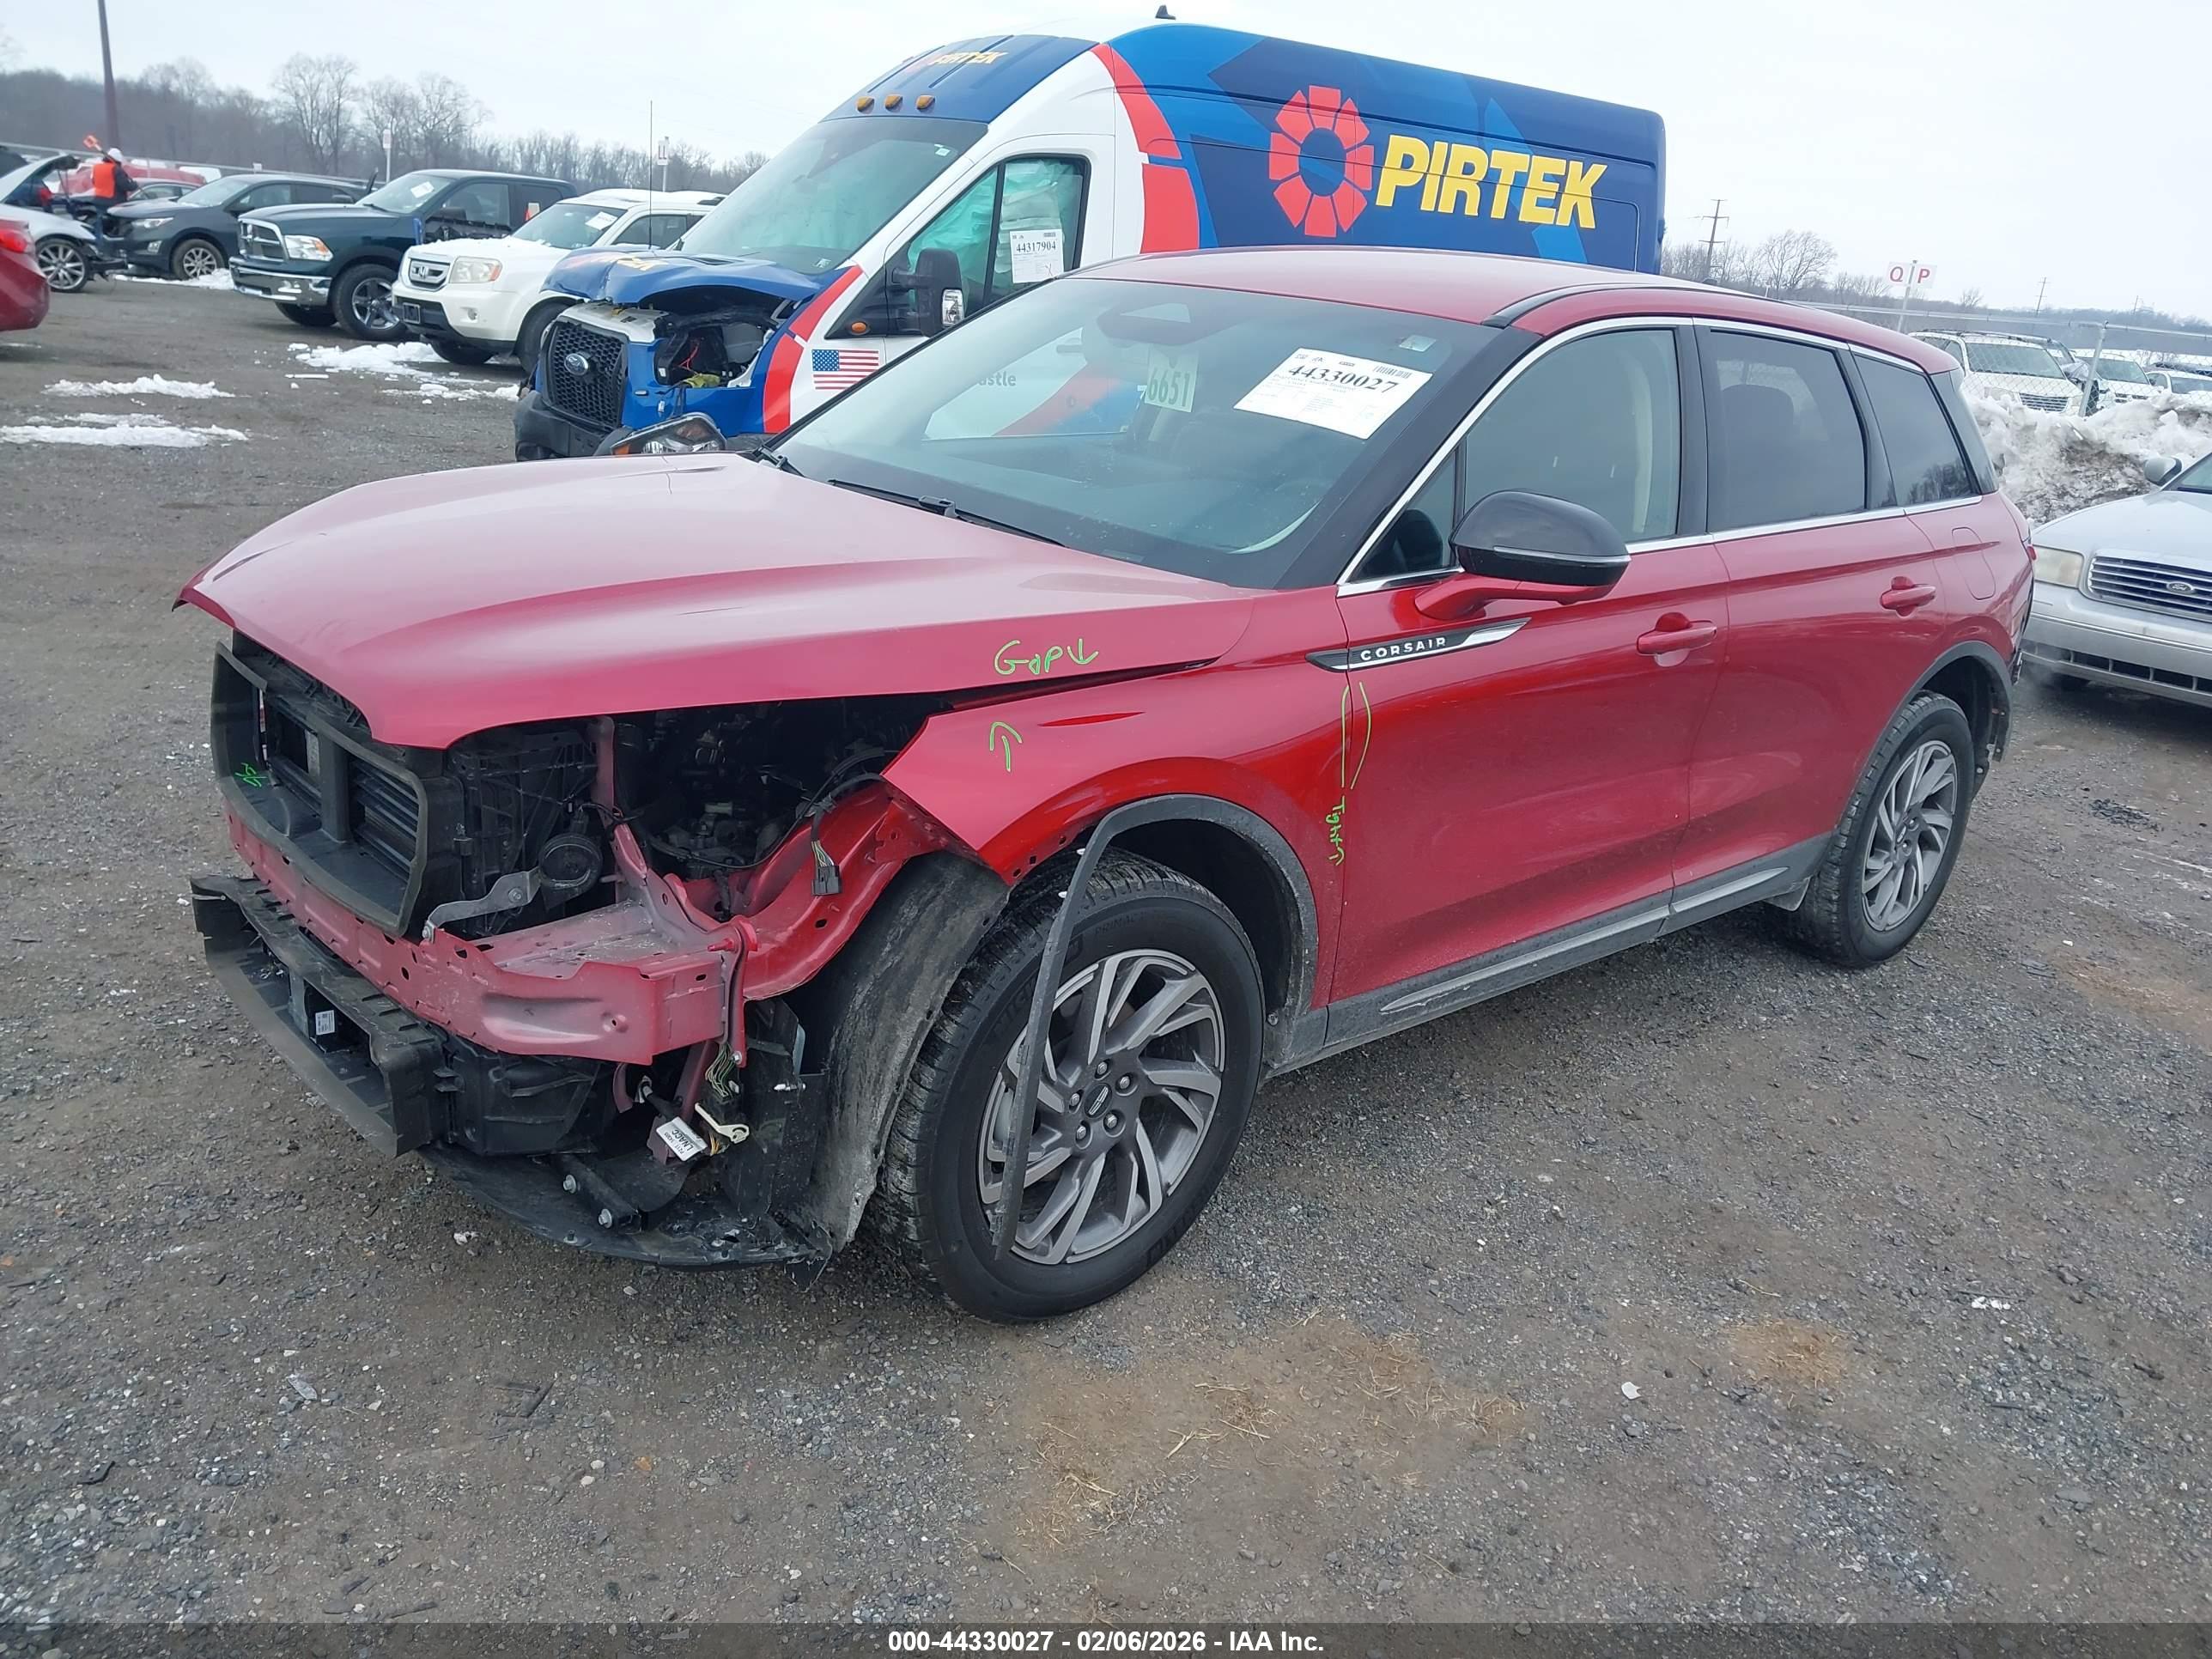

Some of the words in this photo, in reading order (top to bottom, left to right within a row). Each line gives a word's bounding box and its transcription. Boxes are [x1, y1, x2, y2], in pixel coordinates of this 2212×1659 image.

[1376, 134, 1607, 228] PIRTEK
[1016, 240, 1056, 252] 44317904
[1890, 266, 1904, 282] Q
[1917, 268, 1930, 283] P
[1148, 368, 1190, 407] 6651
[1288, 364, 1399, 393] 44330027
[1360, 637, 1446, 661] CORSAIR
[672, 1129, 694, 1152] LNACC
